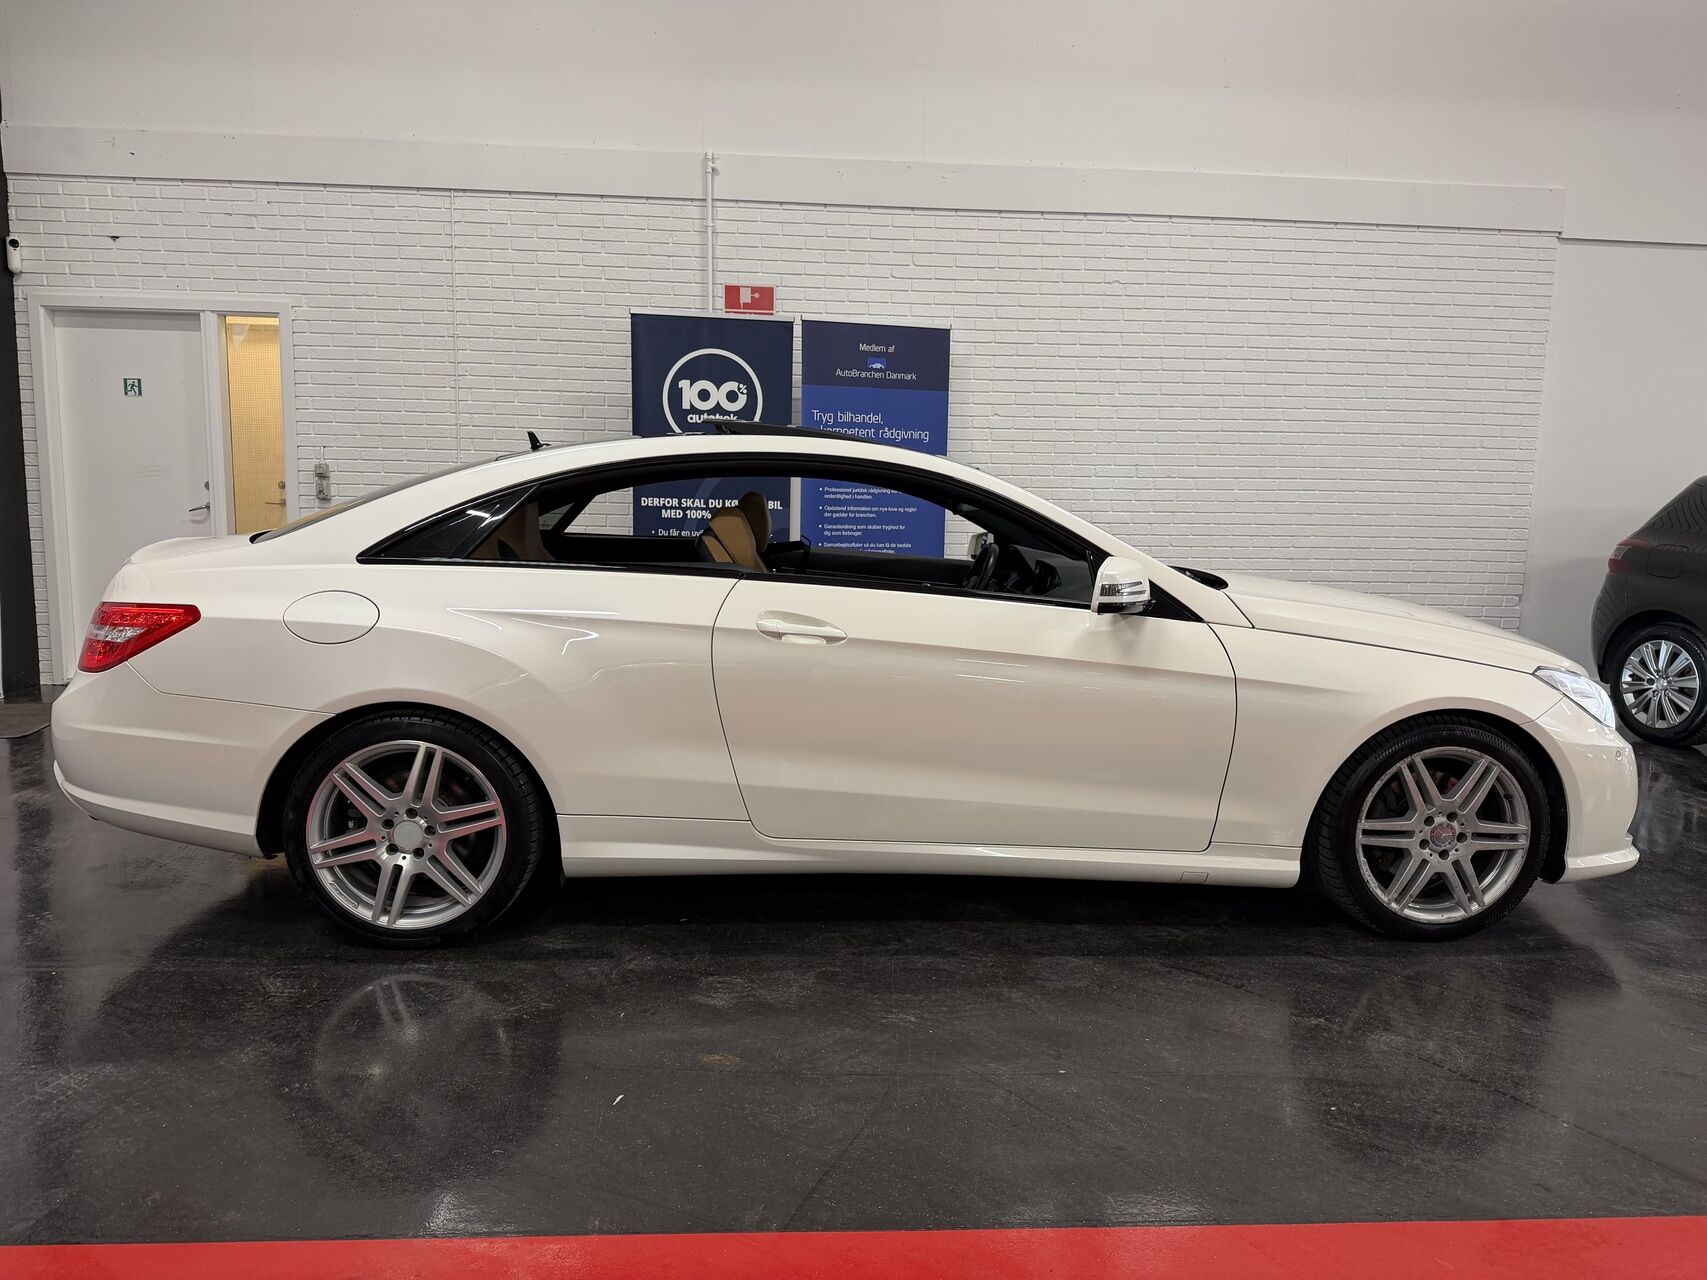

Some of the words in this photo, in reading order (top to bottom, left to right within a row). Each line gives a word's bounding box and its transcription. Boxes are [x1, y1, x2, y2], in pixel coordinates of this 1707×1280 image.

[859, 343, 886, 352] Medlem
[887, 345, 896, 353] af
[835, 368, 884, 379] AutoBranchen
[886, 371, 917, 380] Danmark
[678, 379, 748, 411] 100%
[811, 410, 834, 425] Tryg
[837, 411, 884, 425] bilhandel,
[879, 427, 930, 443] rådgivning
[640, 497, 679, 507] DERFOR
[681, 498, 706, 508] SKAL
[708, 499, 723, 508] DU
[767, 501, 783, 510] BIL
[661, 509, 683, 519] MED
[685, 510, 712, 519] 100%
[669, 528, 680, 537] får
